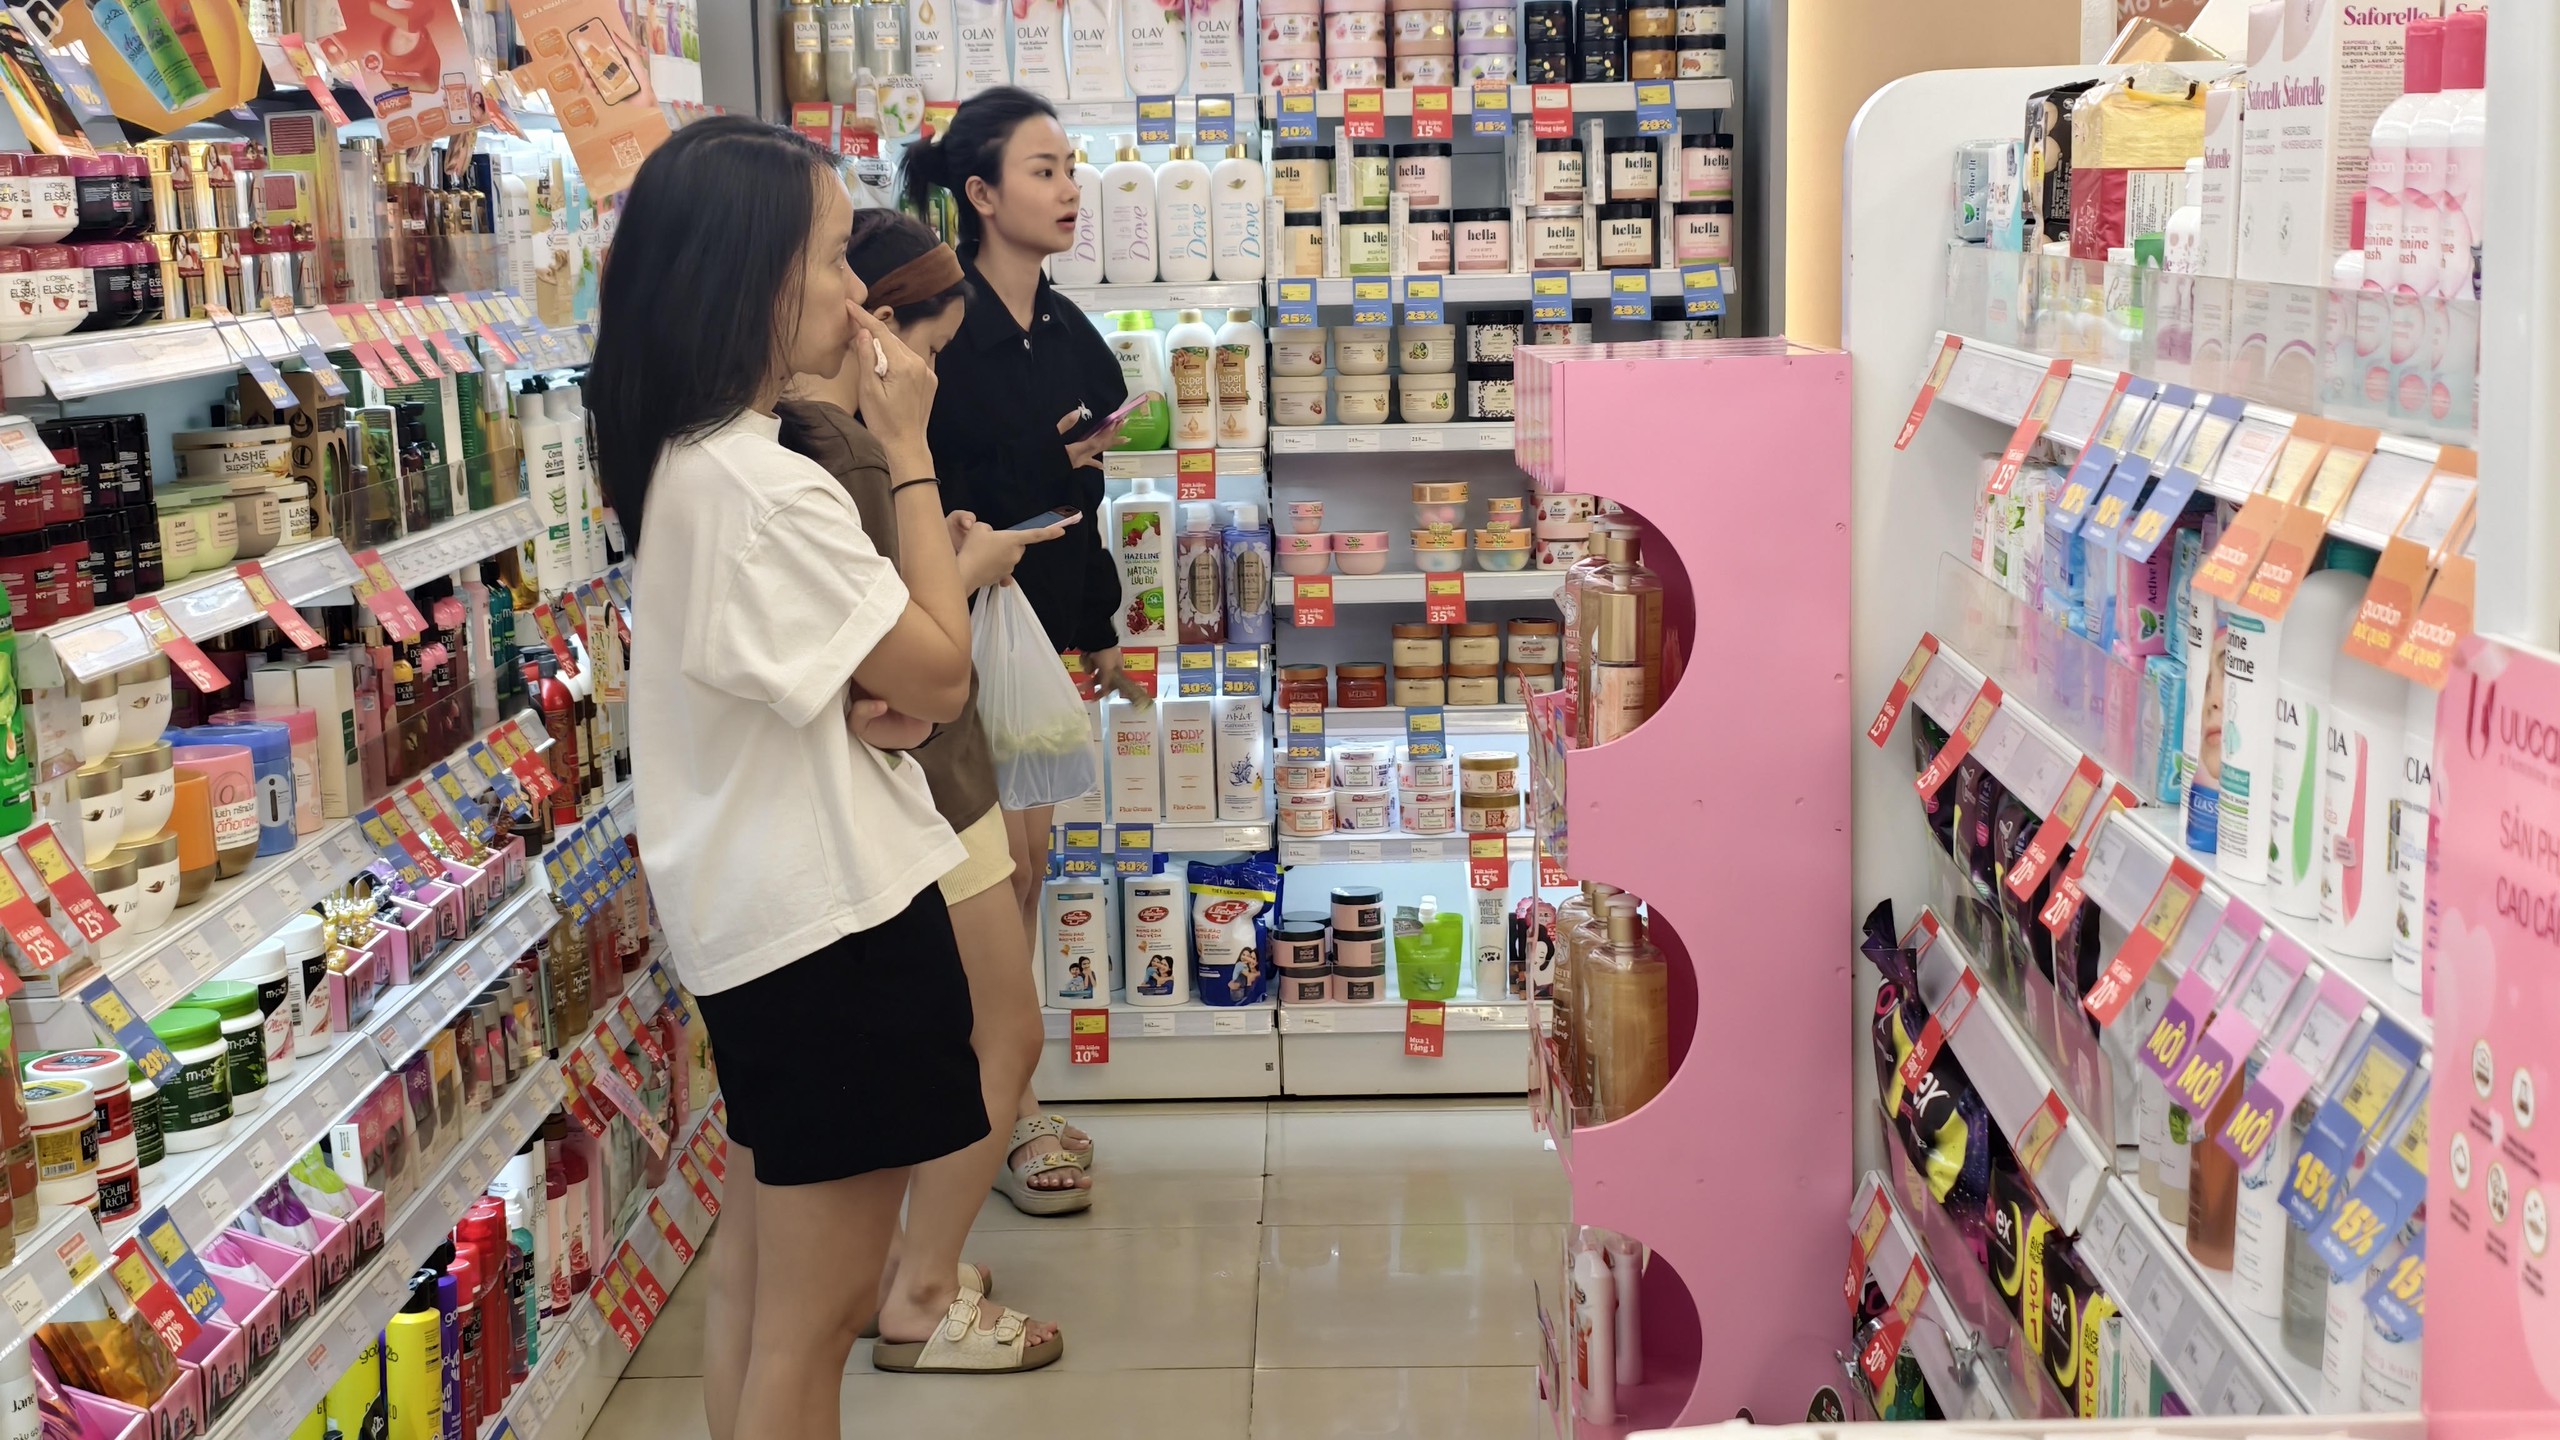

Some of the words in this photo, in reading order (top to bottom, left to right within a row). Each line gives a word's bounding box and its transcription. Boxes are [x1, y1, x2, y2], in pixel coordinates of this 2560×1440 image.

[2343, 5, 2431, 26] Saforelle
[1017, 27, 1049, 39] OLAY
[1198, 20, 1231, 33] OLAY
[915, 31, 940, 41] OLAY
[962, 28, 996, 40] OLAY
[1074, 29, 1105, 41] OLAY
[1132, 27, 1165, 40] OLAY
[1625, 157, 1652, 169] hella
[1703, 155, 1729, 167] hella
[1275, 167, 1300, 178] hella
[1399, 165, 1425, 176] hella
[1128, 205, 1150, 262] Dove
[1187, 203, 1208, 259] Dove
[1239, 202, 1261, 258] Dove
[1467, 229, 1496, 240] hella
[1547, 226, 1575, 238] hella
[1612, 224, 1642, 236] hella
[1690, 222, 1719, 234] hella
[1075, 208, 1096, 263] Dove
[1179, 376, 1204, 386] super
[1220, 374, 1243, 384] super
[223, 450, 267, 464] LASHE
[1181, 486, 1206, 499] 25%
[1125, 552, 1159, 560] HAZELINE
[1127, 566, 1158, 577] MATCHA
[1299, 613, 1323, 625] 35%
[1431, 610, 1455, 623] 35%
[2360, 599, 2402, 626] guardian
[2408, 618, 2456, 647] guardian
[1117, 731, 1151, 743] BODY
[1171, 729, 1204, 741] BODY
[1117, 744, 1151, 756] WASH
[1171, 742, 1204, 754] WASH
[1474, 873, 1498, 886] 15%
[1543, 873, 1568, 886] 15%
[2496, 875, 2531, 929] CAO
[78, 907, 106, 940] 25%
[27, 936, 57, 967] 25%
[2146, 1017, 2187, 1069] MỚI
[1075, 1050, 1100, 1063] 10%
[2176, 1055, 2225, 1110] MỚI
[2226, 1101, 2275, 1159] MỚI
[2294, 1151, 2337, 1213] 15%
[105, 1193, 127, 1208] RICH
[2331, 1197, 2387, 1258] 15%
